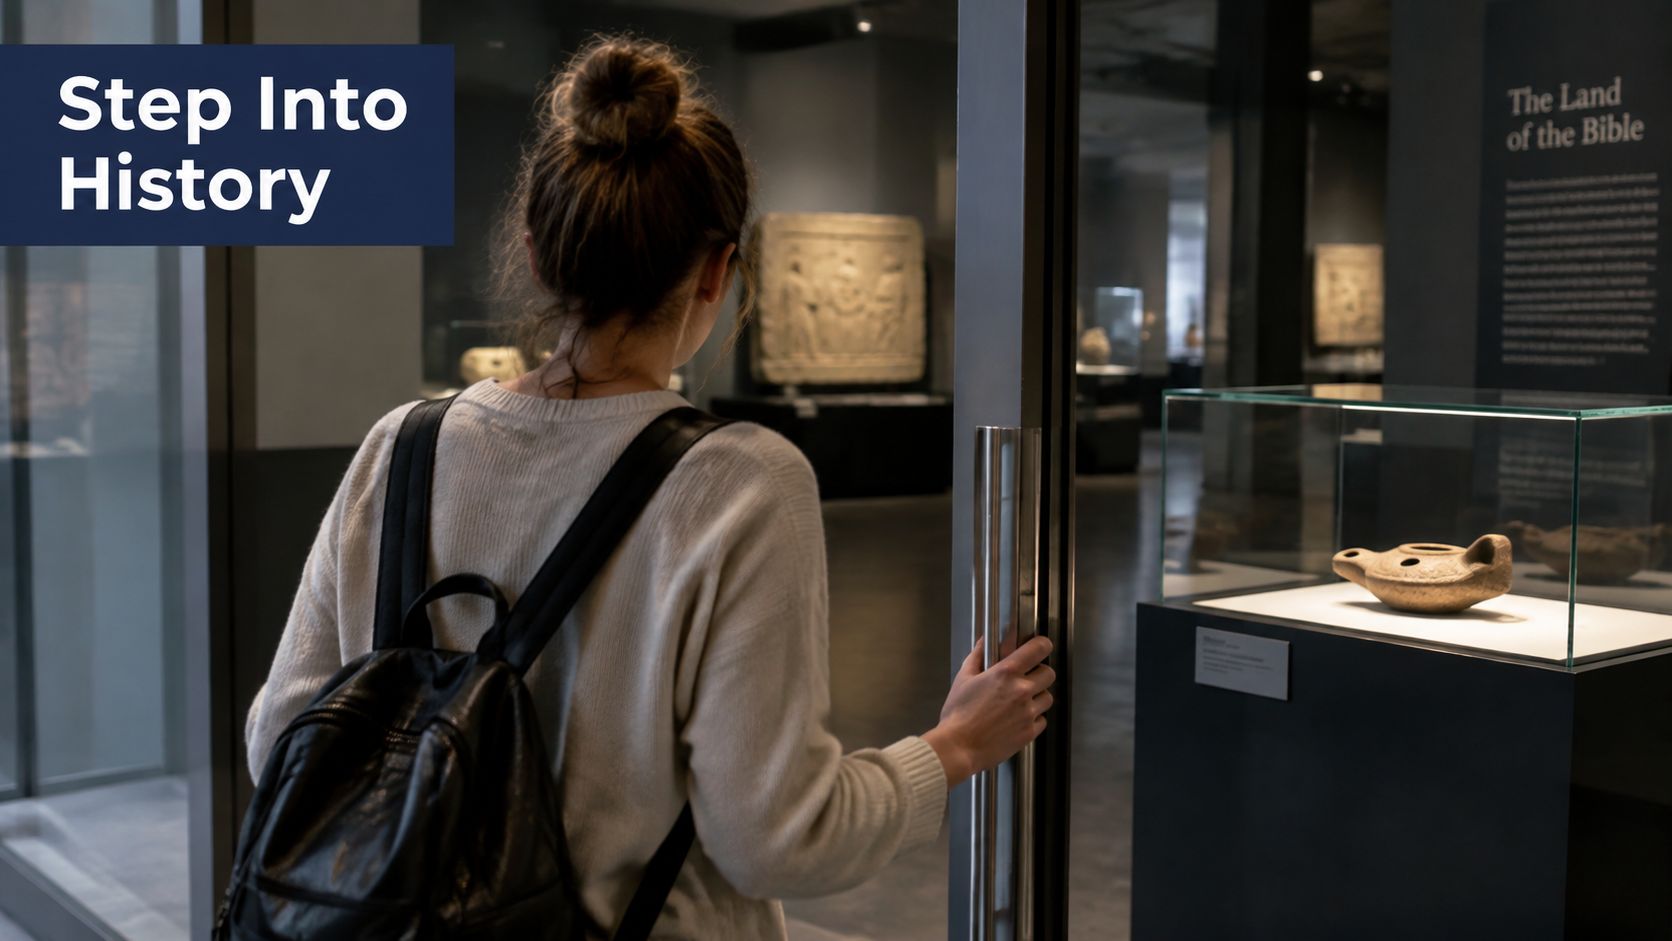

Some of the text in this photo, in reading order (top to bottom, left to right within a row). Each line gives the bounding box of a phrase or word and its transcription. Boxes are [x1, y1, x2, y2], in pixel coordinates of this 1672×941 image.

[1508, 75, 1622, 116] The Land
[1506, 112, 1645, 151] of the Bible
